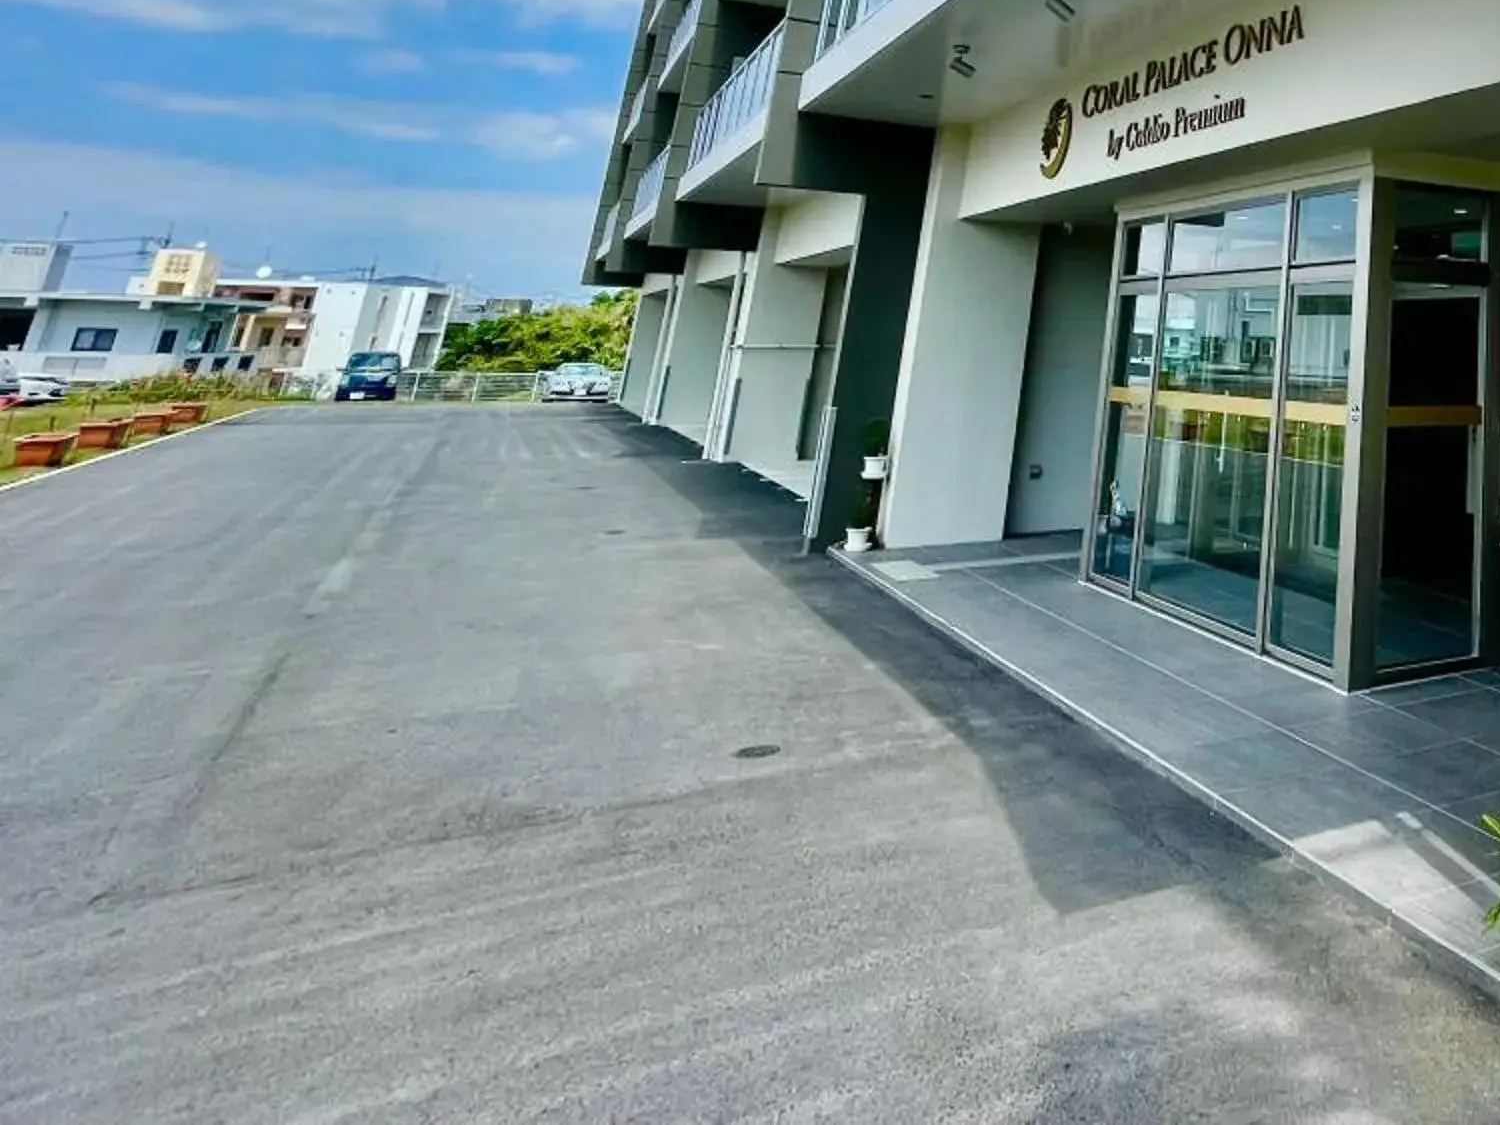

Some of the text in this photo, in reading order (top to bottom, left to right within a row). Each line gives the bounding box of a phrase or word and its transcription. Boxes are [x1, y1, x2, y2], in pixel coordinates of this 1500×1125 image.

[1081, 4, 1305, 118] CORAL PALACE ONNA
[1106, 128, 1126, 160] by
[1173, 94, 1246, 138] Premium
